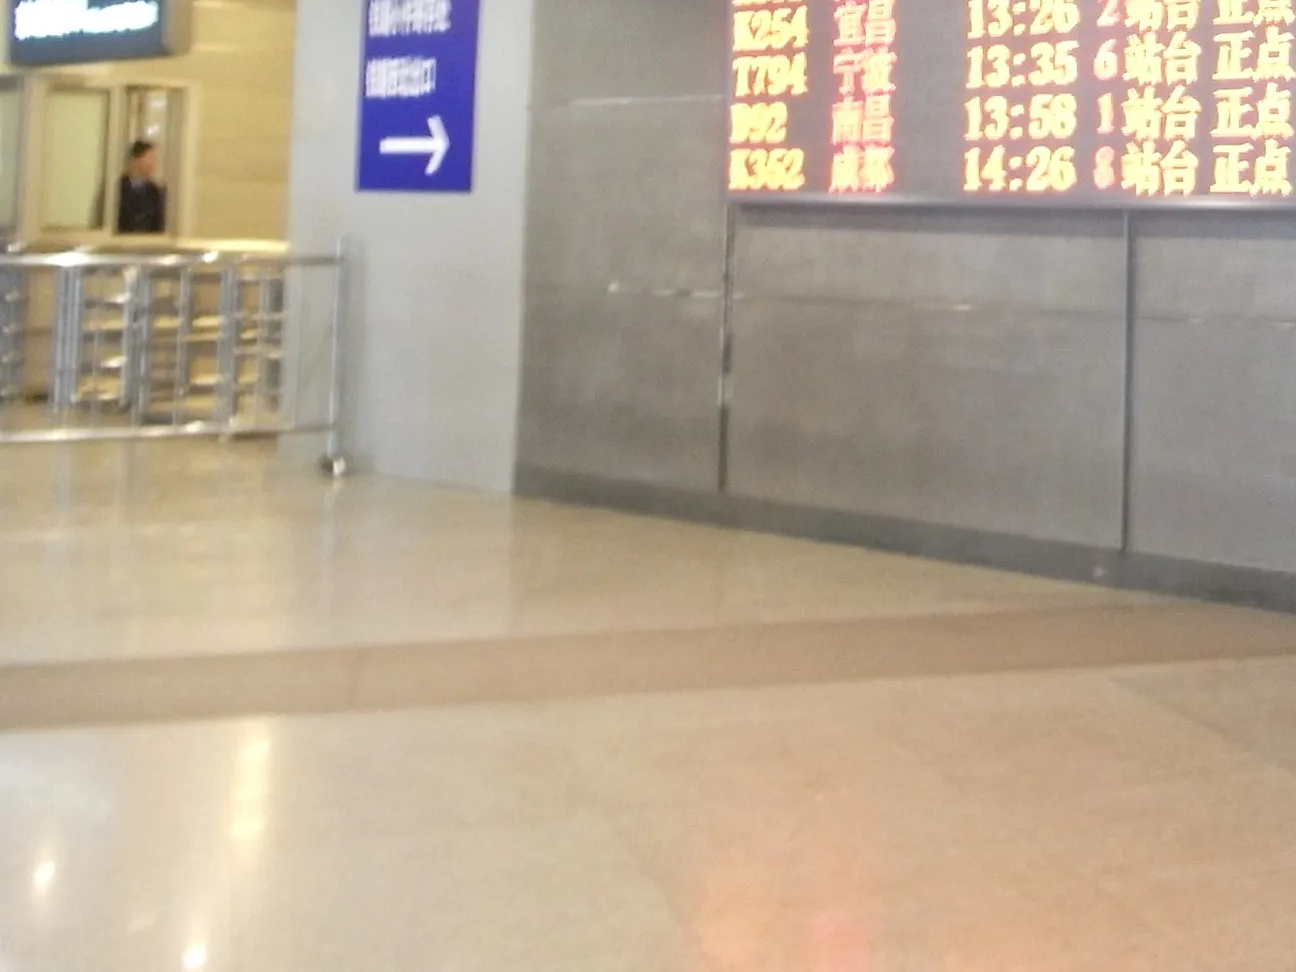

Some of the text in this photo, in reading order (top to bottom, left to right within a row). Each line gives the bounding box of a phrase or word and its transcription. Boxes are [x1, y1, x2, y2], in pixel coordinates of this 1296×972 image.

[732, 51, 809, 97] T794
[966, 40, 1080, 89] 13:35
[964, 92, 1078, 141] 13:58
[1209, 81, 1296, 138] 正点
[963, 144, 1078, 192] 14:26
[1209, 139, 1294, 197] 正点
